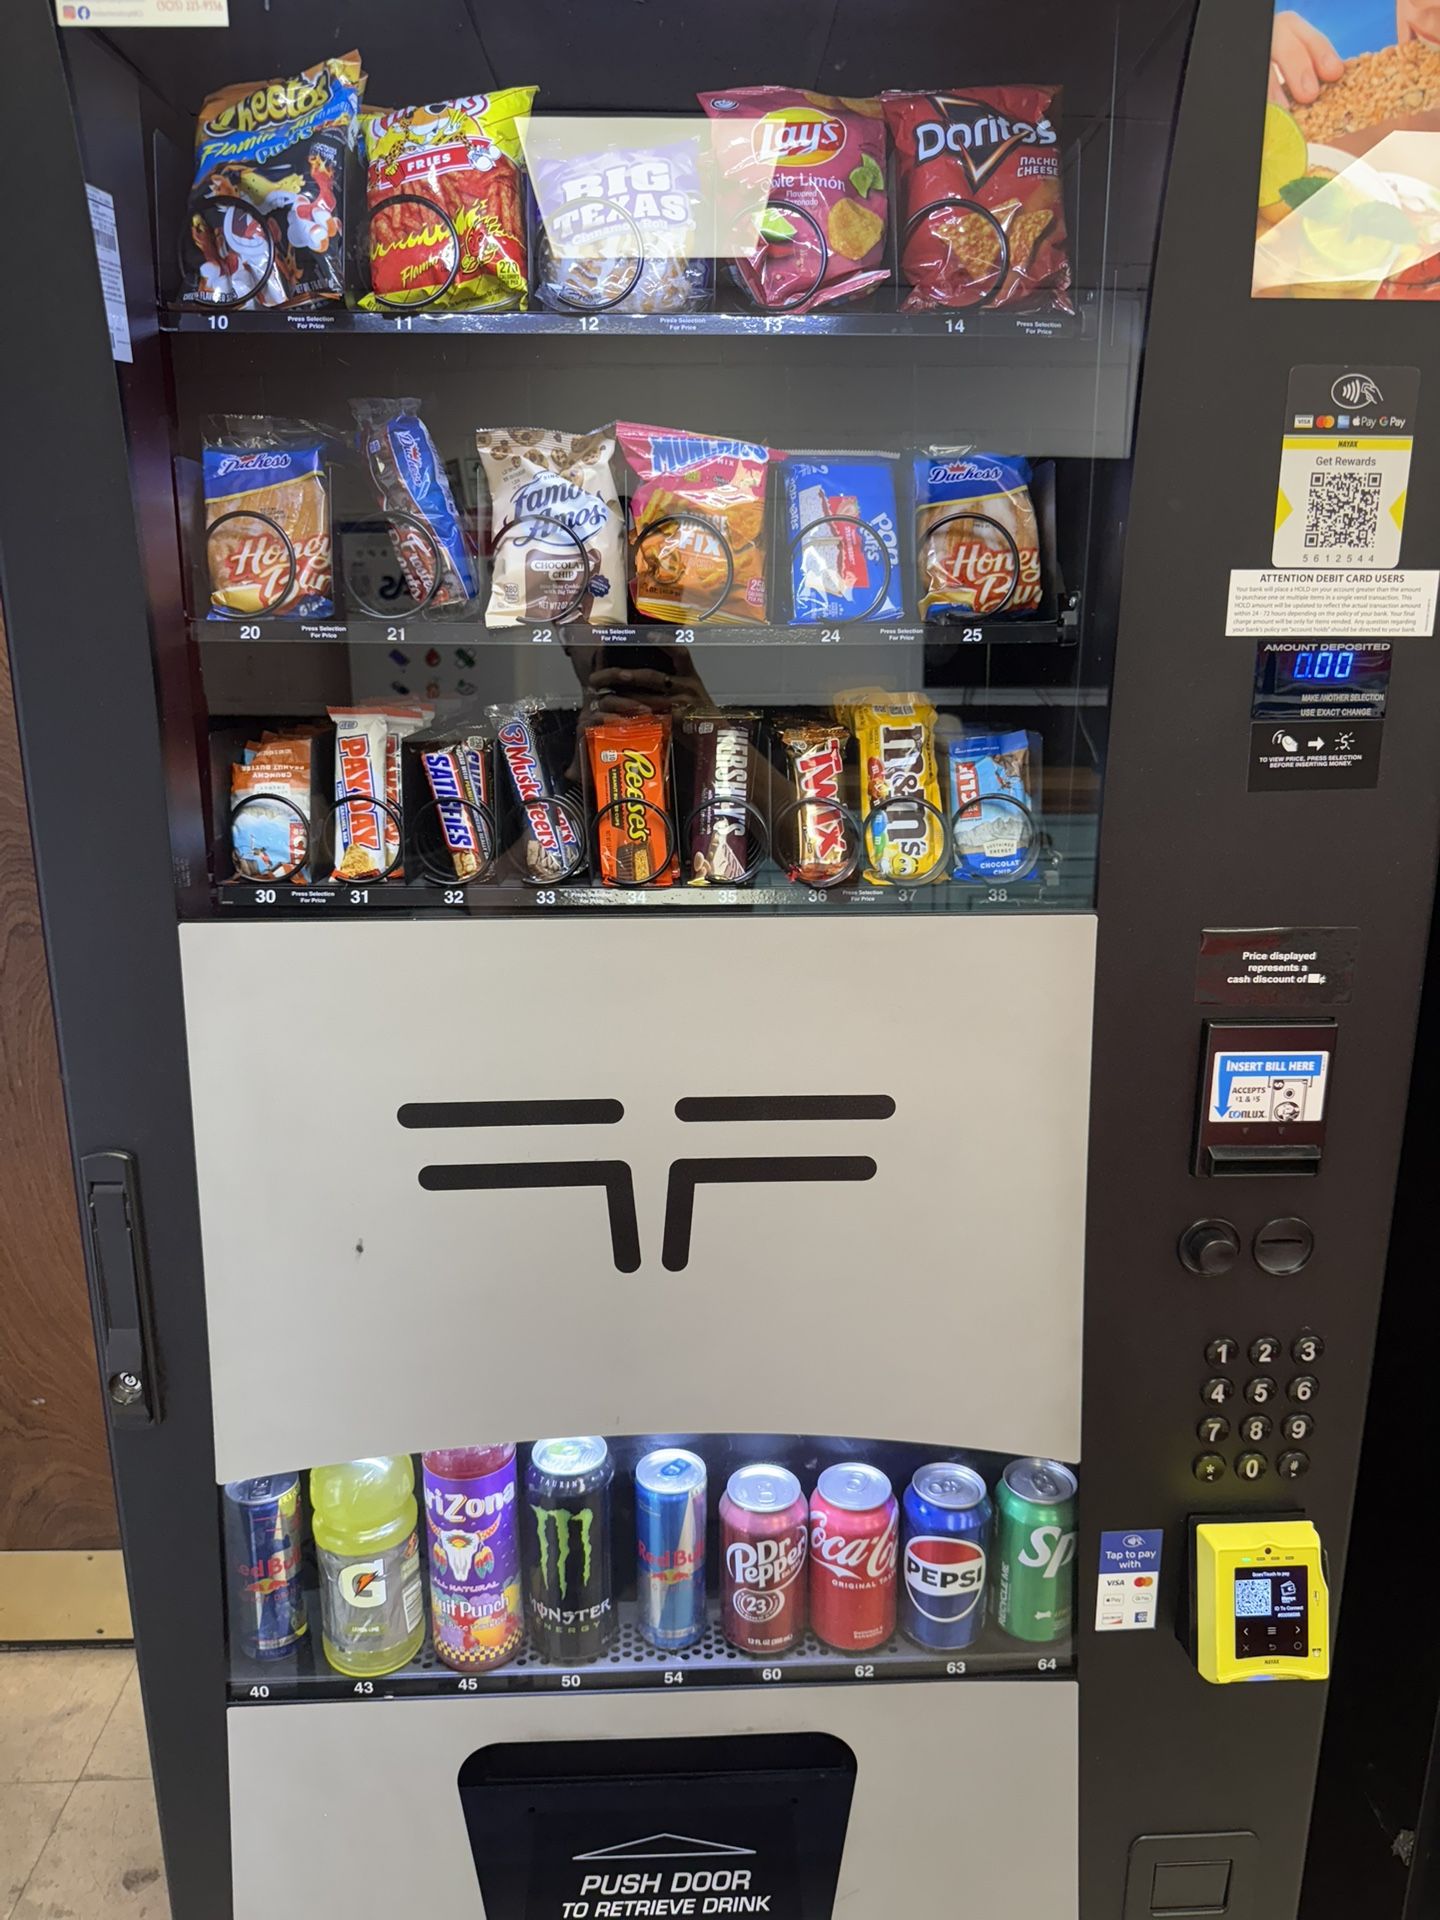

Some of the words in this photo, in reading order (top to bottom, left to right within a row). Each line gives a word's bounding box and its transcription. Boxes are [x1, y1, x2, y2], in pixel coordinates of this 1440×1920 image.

[206, 72, 331, 134] Cheetos
[760, 120, 840, 160] Lay's
[916, 114, 1057, 161] Doritos
[407, 154, 451, 171] FRIES
[1020, 156, 1058, 167] NACHO
[1017, 166, 1059, 178] CHEESE
[563, 162, 672, 202] BIG
[800, 172, 846, 193] Limón
[553, 192, 688, 238] TEXAS
[208, 316, 229, 330] 10
[287, 315, 306, 323] Press
[306, 315, 335, 323] Selection
[395, 317, 412, 330] 11
[579, 317, 600, 331] 12
[945, 319, 965, 333] 14
[1361, 416, 1376, 429] Pay
[1389, 416, 1406, 428] Pay
[217, 453, 291, 476] Duchess
[1316, 457, 1334, 466] Get
[1335, 457, 1377, 466] Rewards
[929, 463, 1001, 482] Duchess
[515, 502, 606, 546] Amos
[679, 530, 721, 557] FIX
[231, 534, 332, 576] Honey
[945, 543, 1040, 582] Honey
[552, 571, 574, 579] CHIP
[1260, 574, 1314, 583] ATTENTION
[1316, 574, 1344, 583] DEBIT
[1346, 574, 1373, 583] CARD
[1375, 574, 1405, 583] USERS
[261, 565, 332, 606] Bun
[974, 574, 1043, 612] Bun
[240, 626, 261, 639] 20
[387, 627, 406, 641] 21
[532, 629, 552, 642] 22
[675, 629, 694, 643] 23
[821, 629, 841, 643] 24
[962, 628, 982, 642] 25
[1264, 643, 1317, 651] AMOUNT
[1320, 643, 1391, 651] DEPOSITED
[1293, 652, 1354, 679] 0.00
[1301, 694, 1320, 702] MAKE
[1321, 694, 1350, 702] ANOTHER
[1300, 708, 1316, 717] USE
[1317, 708, 1340, 717] EXACT
[1341, 708, 1372, 716] CHANGE
[500, 723, 525, 746] 3
[714, 728, 749, 836] HERSHEY'S
[339, 735, 380, 850] PAYDAY
[623, 748, 655, 843] Reese's
[799, 739, 847, 858] TWIX
[255, 890, 276, 903] 30
[350, 890, 369, 903] 31
[444, 890, 464, 904] 32
[536, 890, 556, 904] 33
[719, 890, 737, 904] 35
[808, 889, 828, 902] 36
[898, 889, 917, 902] 37
[988, 889, 1008, 902] 38
[1242, 951, 1268, 960] Price
[1269, 951, 1316, 962] displayed
[1248, 963, 1299, 974] represents
[1227, 974, 1251, 984] cash
[1252, 974, 1295, 984] discount
[1296, 974, 1307, 984] of
[1226, 1060, 1264, 1072] INSERT
[1265, 1061, 1288, 1071] BILL
[1288, 1061, 1315, 1071] HERE
[1217, 1344, 1228, 1363] 1
[1259, 1343, 1272, 1362] 2
[1301, 1342, 1315, 1361] 3
[1211, 1384, 1225, 1403] 4
[1254, 1384, 1268, 1402] 5
[1297, 1382, 1311, 1401] 6
[1208, 1423, 1220, 1442] 7
[1250, 1421, 1263, 1440] 8
[1291, 1420, 1306, 1439] 9
[1246, 1459, 1259, 1478] 0
[756, 1537, 791, 1565] Dr
[1105, 1550, 1124, 1561] Tap
[1125, 1550, 1136, 1559] to
[1138, 1550, 1156, 1561] pay
[727, 1532, 805, 1588] Pepper
[1119, 1560, 1141, 1569] with
[907, 1560, 983, 1588] PEPSI
[338, 1558, 387, 1609] G
[449, 1581, 500, 1593] NATURAL
[831, 1579, 877, 1590] ORIGINAL
[459, 1593, 509, 1618] Punch
[746, 1596, 767, 1614] 23
[854, 1665, 874, 1677] 62
[946, 1662, 966, 1674] 63
[1037, 1658, 1057, 1670] 64
[561, 1675, 581, 1687] 50
[664, 1672, 683, 1684] 54
[762, 1668, 782, 1680] 60
[353, 1682, 374, 1694] 43
[458, 1678, 478, 1690] 45
[250, 1686, 269, 1698] 40
[580, 1873, 662, 1895] PUSH
[670, 1870, 751, 1893] DOOR
[562, 1902, 589, 1919] TO
[594, 1898, 697, 1917] RETRIEVE
[702, 1895, 771, 1914] DRINK
